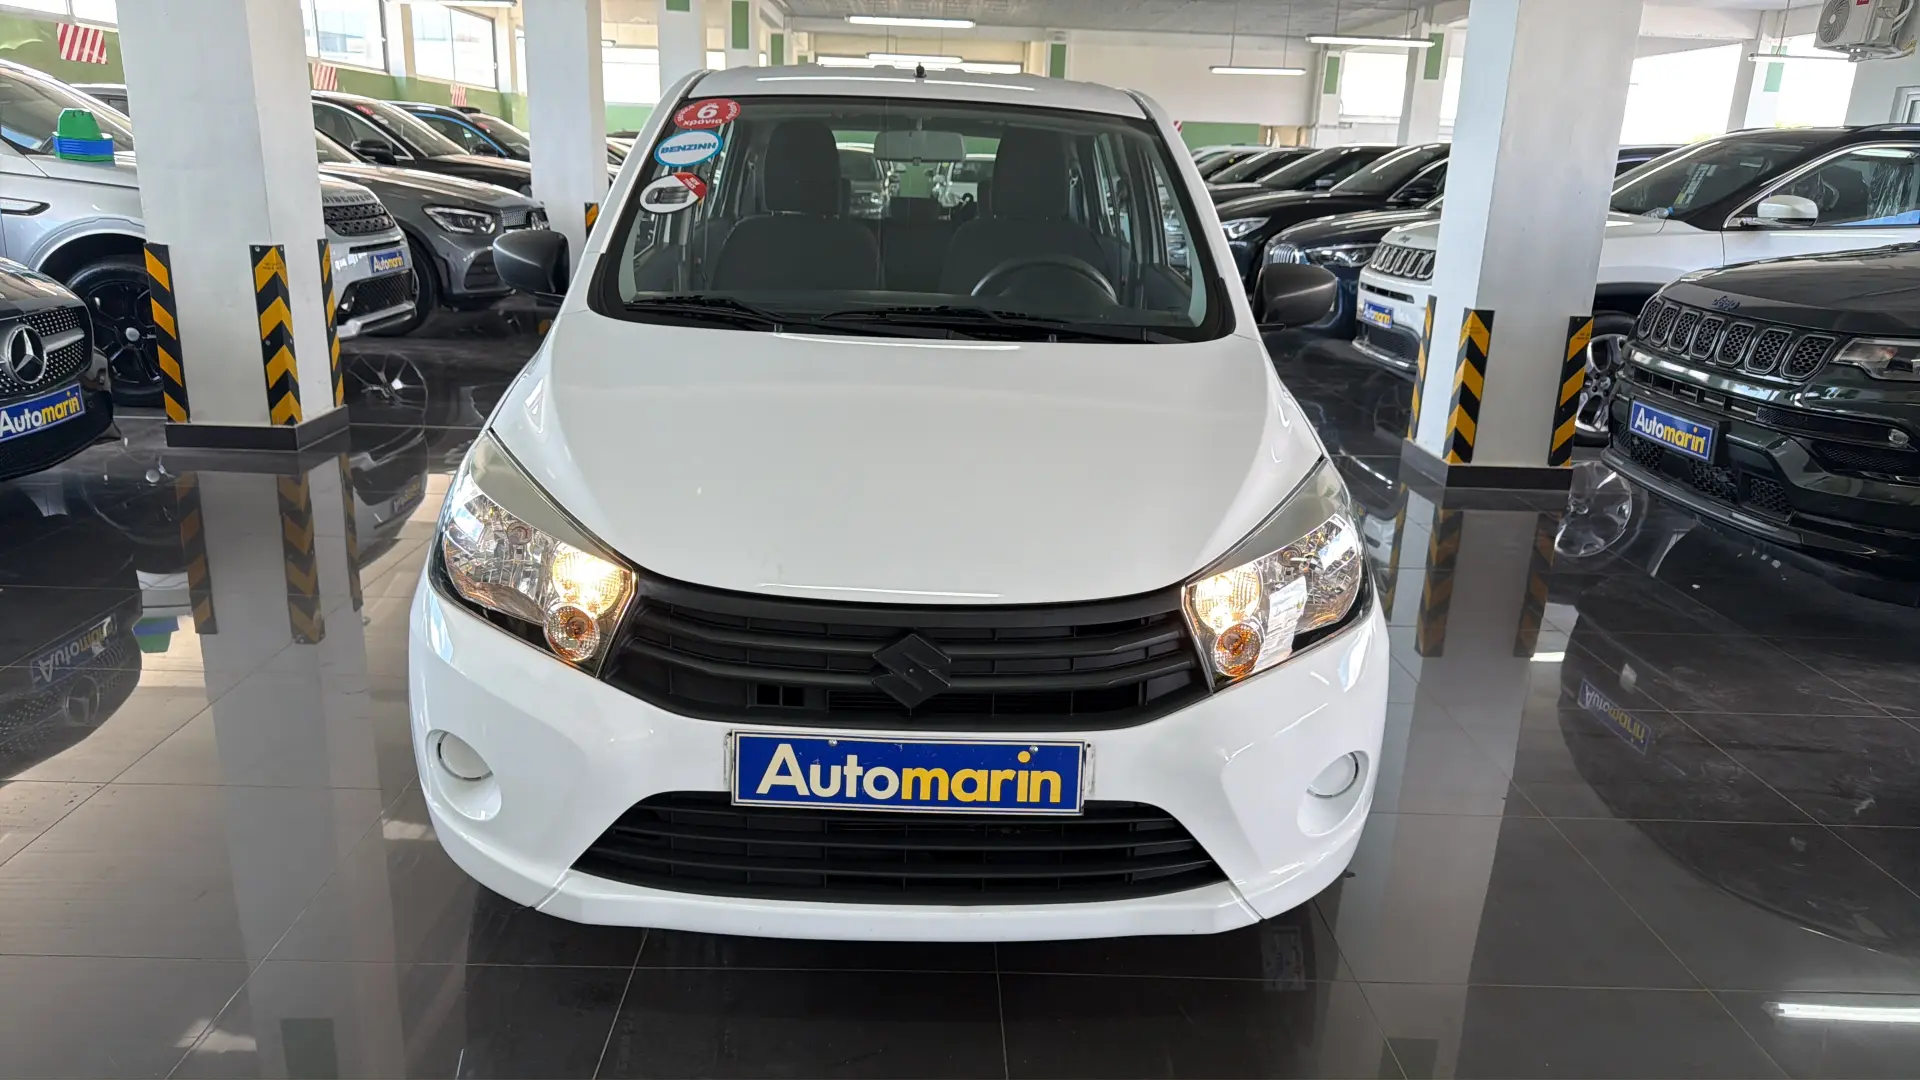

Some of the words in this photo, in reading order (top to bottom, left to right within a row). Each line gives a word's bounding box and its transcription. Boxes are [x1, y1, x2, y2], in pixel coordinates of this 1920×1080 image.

[0, 391, 80, 438] Automarin
[1634, 407, 1705, 454] Automarin
[756, 743, 1062, 803] Automarin
